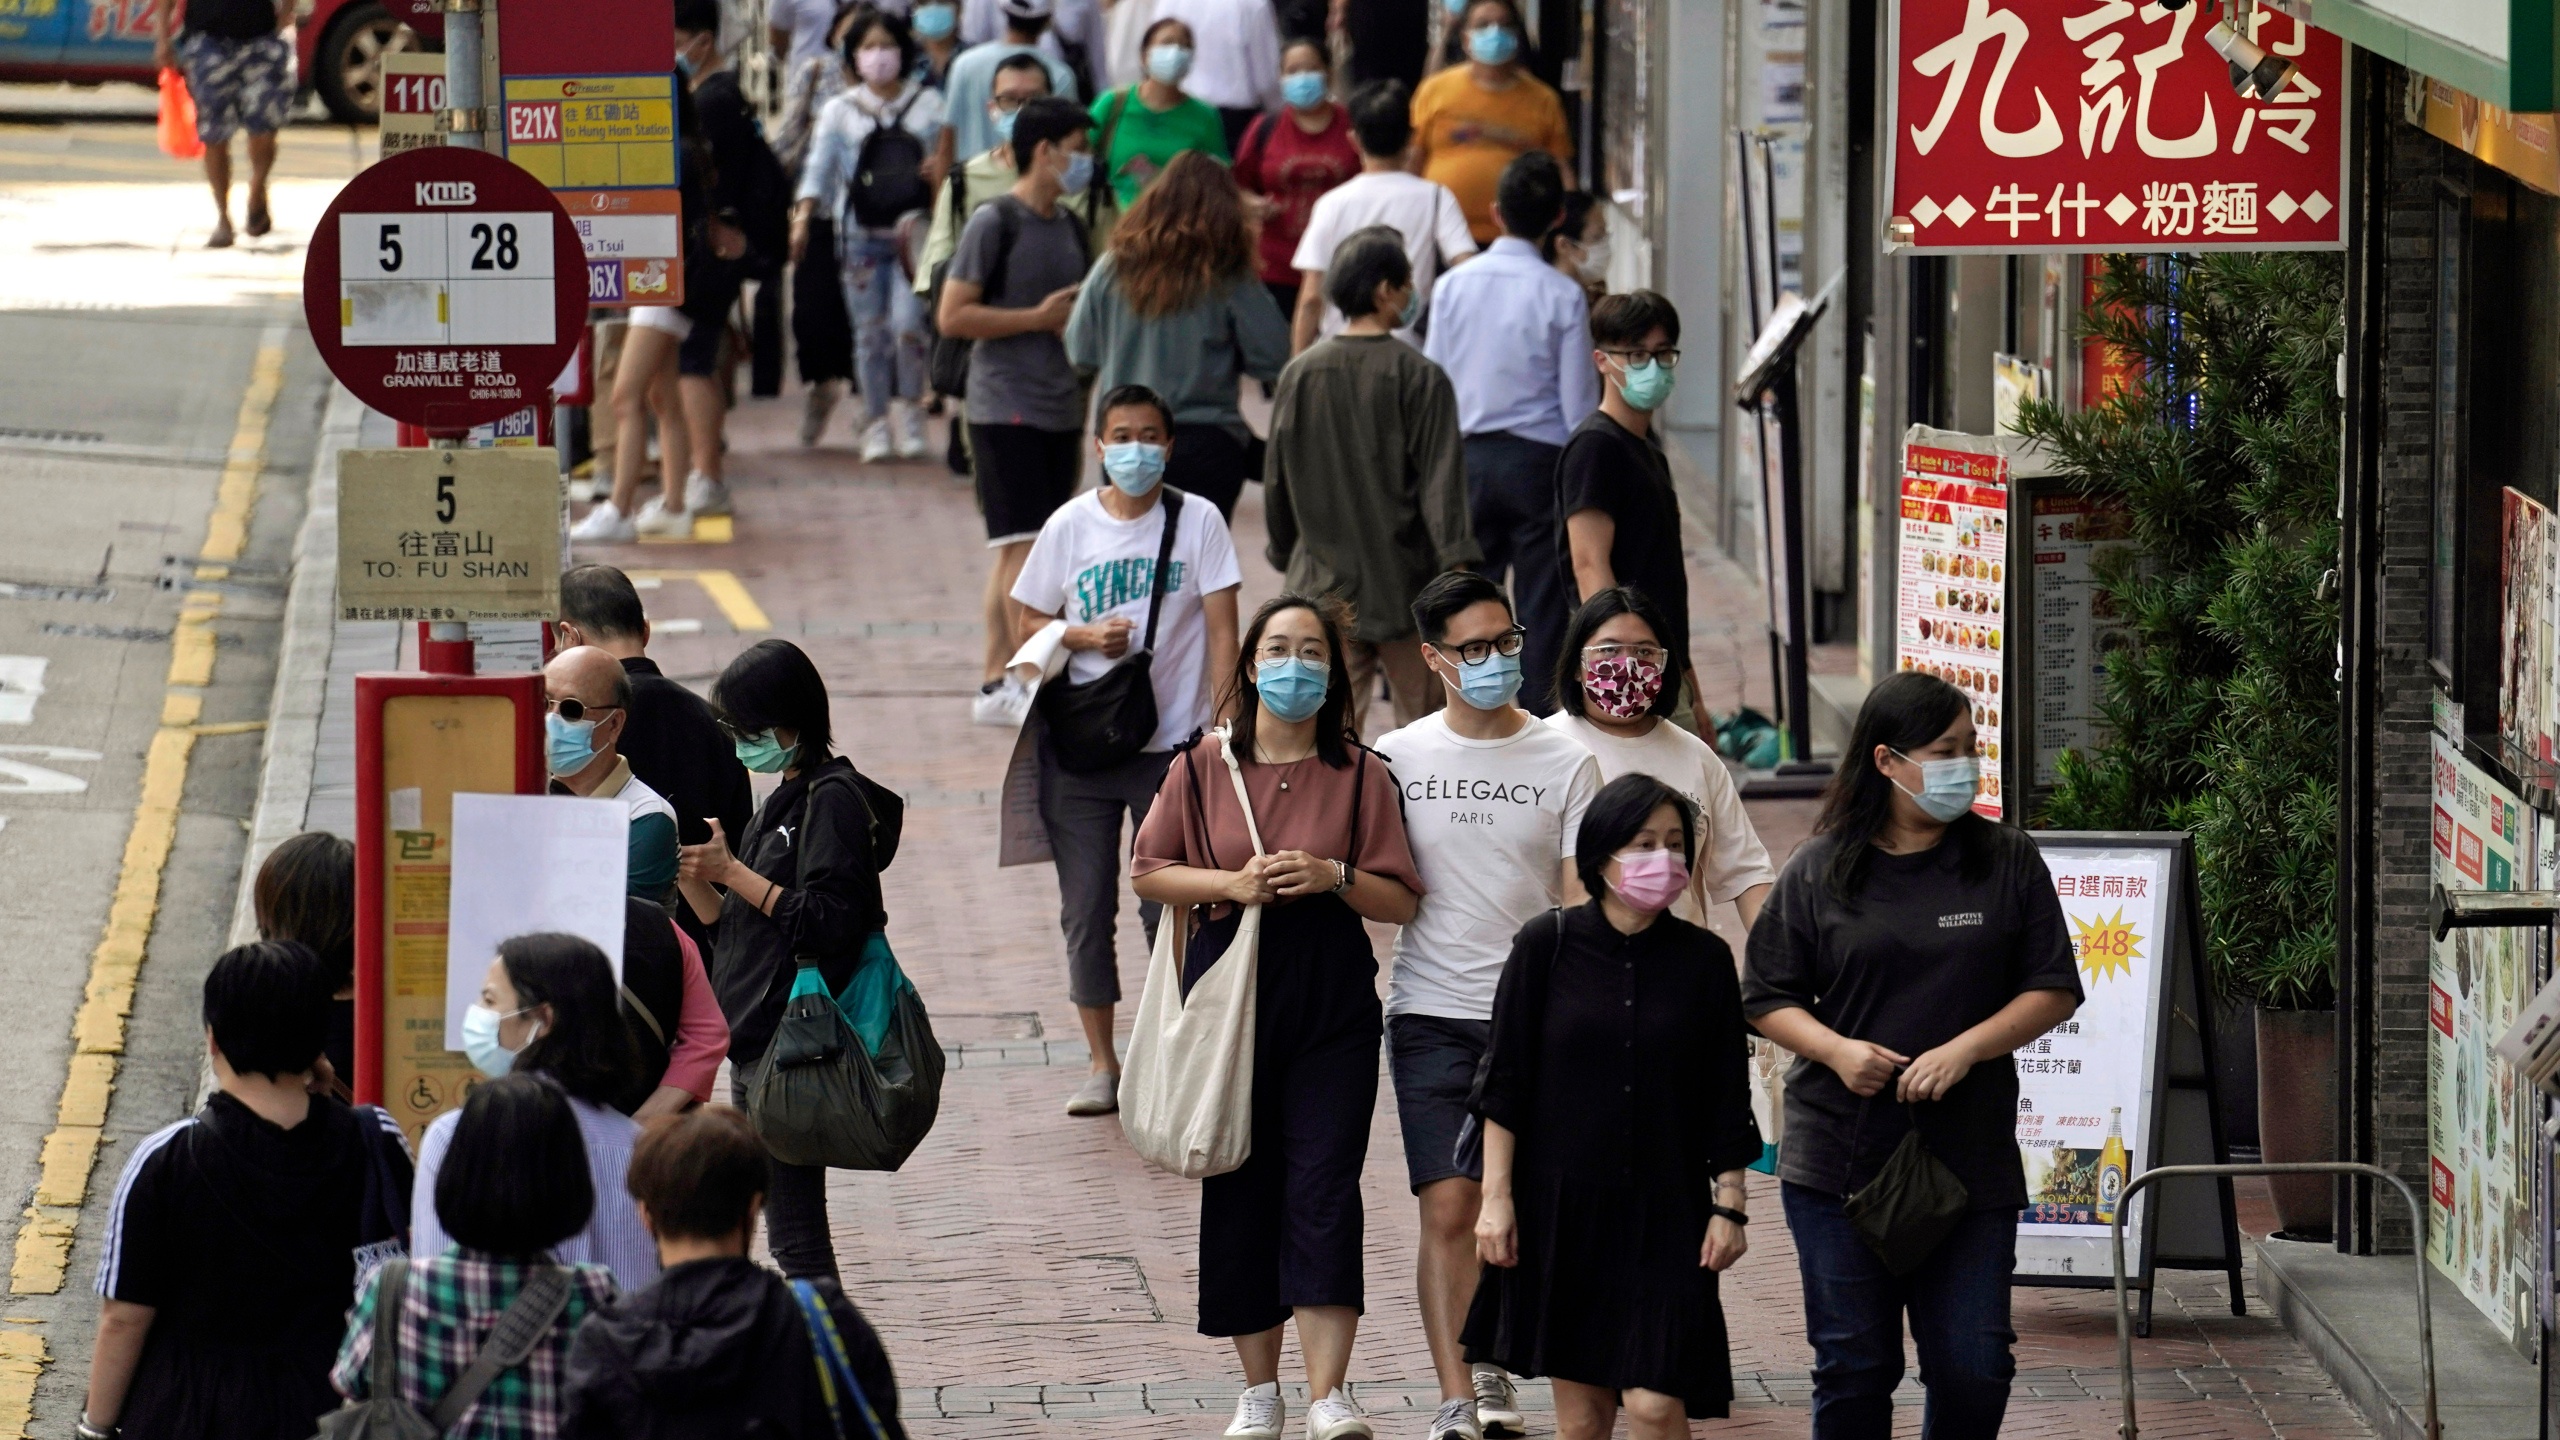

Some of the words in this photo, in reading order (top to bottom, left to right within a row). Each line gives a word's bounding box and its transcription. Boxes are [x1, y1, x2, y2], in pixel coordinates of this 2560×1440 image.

[1911, 0, 2218, 159] 九記
[394, 77, 446, 112] 110
[509, 103, 558, 140] E21X
[565, 107, 578, 121] 往
[565, 126, 576, 137] to
[579, 125, 605, 139] Hung
[608, 125, 632, 136] Hom
[635, 123, 670, 136] Station
[415, 181, 477, 206] KMB
[1984, 182, 2100, 238] 牛什
[2141, 180, 2258, 237] 粉麵
[379, 225, 403, 272] 5
[471, 223, 519, 270] 28
[598, 239, 624, 252] Tsui
[395, 351, 502, 373] 加連威老道
[383, 375, 464, 388] GRANVILLE
[474, 374, 516, 387] ROAD
[437, 476, 456, 524] 5
[398, 530, 494, 557] 往富山
[363, 561, 402, 578] TO:
[417, 561, 448, 578] FU
[463, 561, 530, 578] SHAN
[345, 607, 444, 620] 請在此排隊上車
[469, 610, 499, 619] Please
[502, 612, 529, 620] queue
[532, 610, 552, 619] here
[1406, 774, 1546, 806] CÉLEGACY
[1451, 812, 1494, 825] PARIS
[2057, 875, 2147, 898] 自選兩款
[1938, 912, 1983, 922] ACCEPTIVE
[1938, 918, 1983, 928] WILLINGLY
[2080, 930, 2129, 957] $48
[2019, 1098, 2033, 1112] 魚
